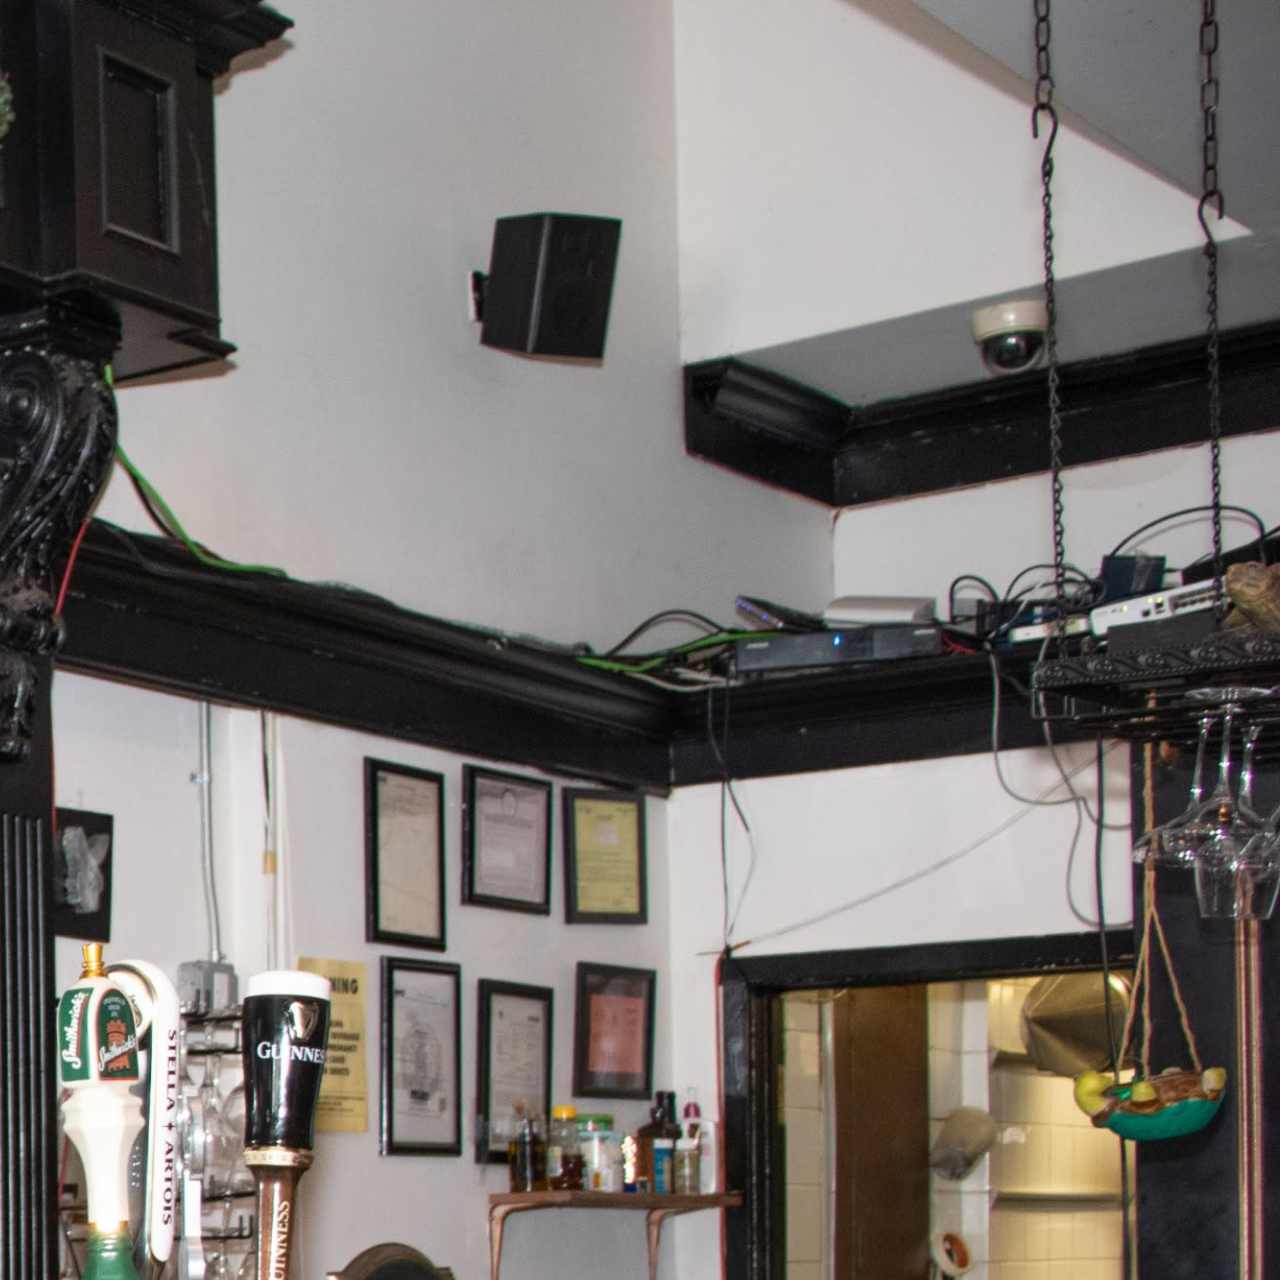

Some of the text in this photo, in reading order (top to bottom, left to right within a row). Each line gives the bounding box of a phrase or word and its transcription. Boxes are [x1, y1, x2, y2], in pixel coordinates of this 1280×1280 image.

[329, 977, 359, 996] NING
[161, 1029, 178, 1226] STELLA ARTOIS
